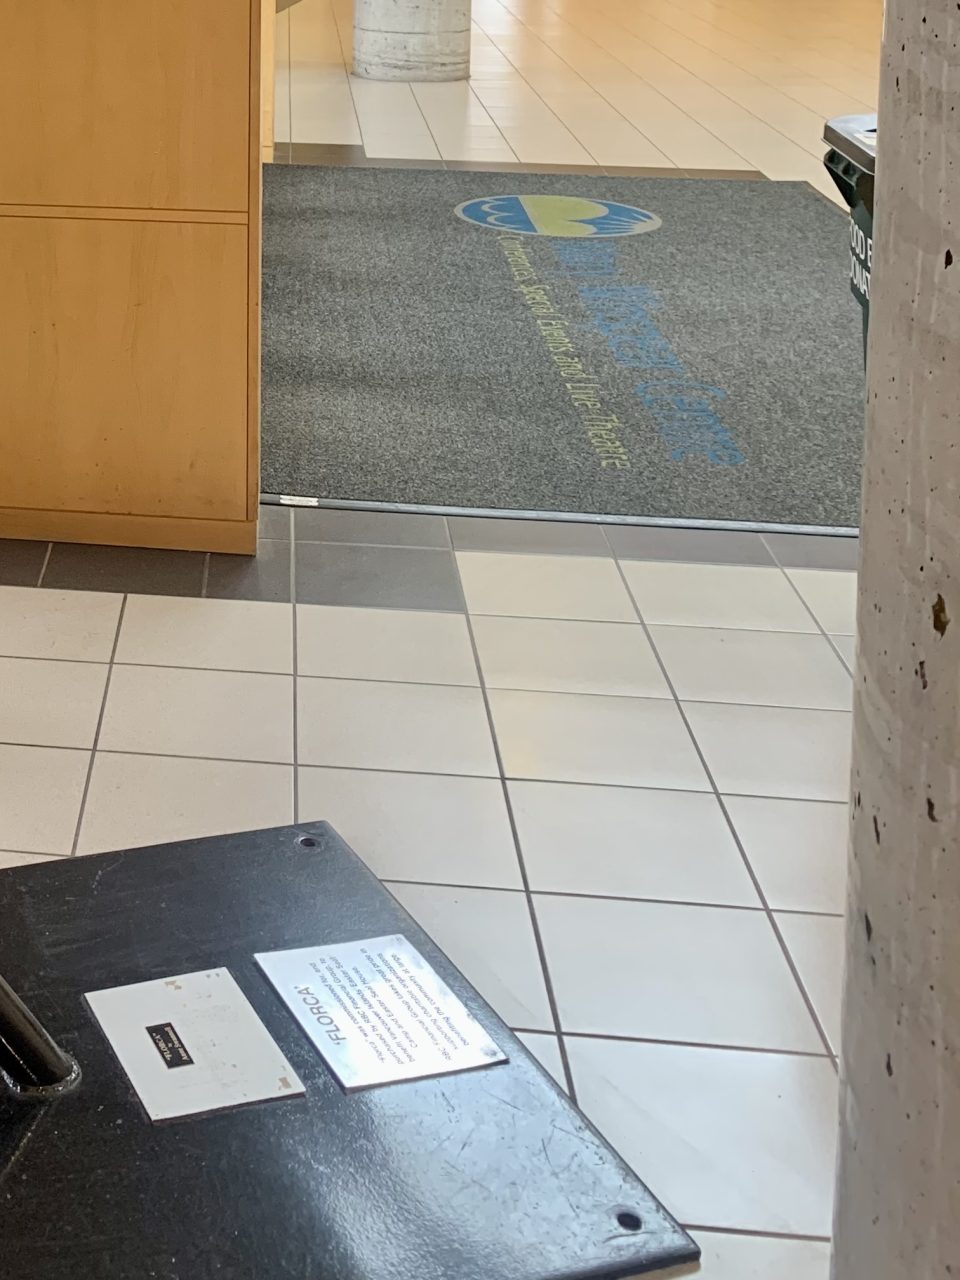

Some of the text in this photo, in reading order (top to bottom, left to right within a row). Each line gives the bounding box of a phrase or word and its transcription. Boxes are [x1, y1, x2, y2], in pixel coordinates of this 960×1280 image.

[537, 318, 575, 352] Events
[554, 355, 598, 379] and
[566, 382, 601, 408] Live
[583, 413, 631, 468] Theatre
[308, 962, 320, 973] and
[364, 954, 380, 968] pride
[376, 952, 408, 988] organizations
[340, 969, 357, 987] Easter
[375, 968, 391, 983] great
[337, 983, 360, 1009] Financial
[364, 985, 379, 998] Seal
[389, 983, 403, 999] takes
[408, 975, 435, 1005] community
[324, 983, 359, 1024] commissioned
[376, 999, 394, 1017] Easter
[401, 999, 418, 1018] Group
[433, 1006, 444, 1015] the
[356, 1010, 371, 1023] RBC
[371, 1010, 397, 1040] Vancouver
[390, 1017, 403, 1029] and
[357, 1025, 368, 1037] was
[369, 1024, 378, 1032] by
[401, 1030, 418, 1048] Camp
[375, 1033, 404, 1064] purchased
[395, 1040, 415, 1062] benefit
